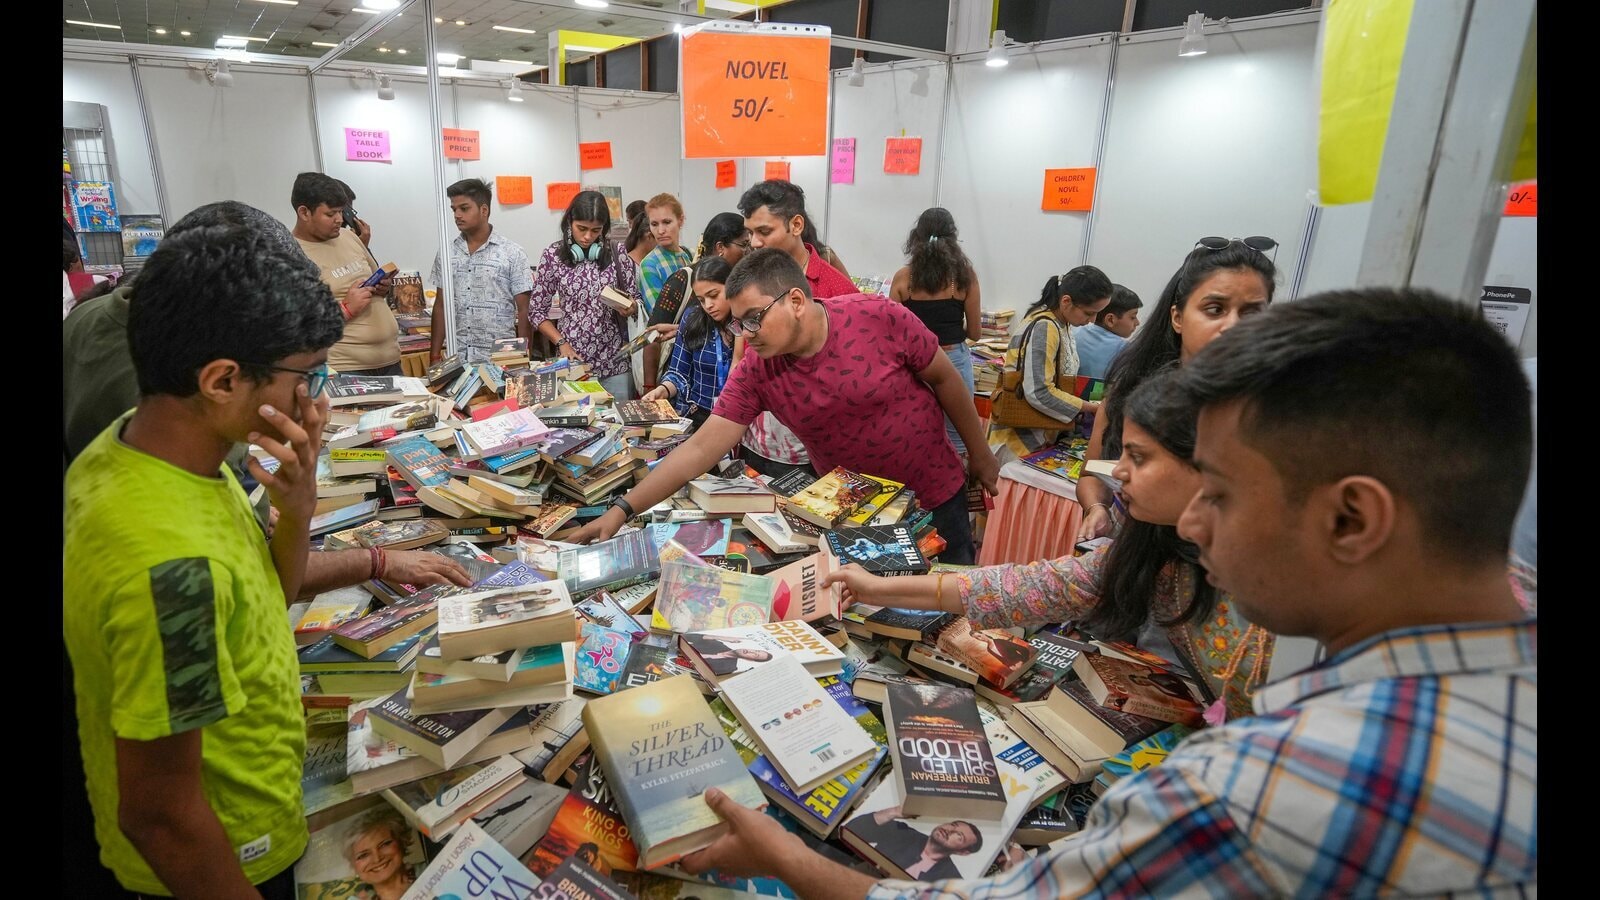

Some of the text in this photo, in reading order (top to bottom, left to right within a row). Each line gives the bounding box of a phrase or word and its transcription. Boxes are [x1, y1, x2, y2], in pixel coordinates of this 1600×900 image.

[726, 61, 788, 79] NOVEL
[732, 97, 773, 121] 50/-
[352, 130, 382, 138] COFFEE
[1510, 192, 1531, 204] 0/-
[391, 276, 421, 286] JANTA
[1487, 291, 1516, 299] PhonePe
[402, 448, 431, 463] bed
[407, 454, 449, 471] narrow
[893, 527, 912, 546] RIG
[901, 546, 920, 566] THE
[802, 564, 816, 616] KISMET
[762, 623, 804, 652] DYER
[780, 621, 835, 655] DANNY
[1038, 654, 1073, 669] PATH
[832, 684, 844, 692] for
[832, 691, 850, 700] hing
[382, 701, 417, 721] SHARON
[417, 717, 455, 738] BOLTON
[650, 720, 672, 732] THE
[629, 722, 714, 757] SILVER
[899, 738, 980, 761] BLOOD
[628, 737, 724, 777] THREAD
[920, 759, 996, 776] SPILLED
[460, 766, 502, 794] SHADOWS
[641, 758, 728, 790] KYLIE FITZPATRICK
[912, 772, 990, 784] BRIAN FREEMAN
[804, 779, 848, 819] DEE
[583, 806, 614, 830] KING
[584, 821, 624, 849] KINGS
[422, 832, 475, 891] Alison Penton
[460, 850, 504, 898] UP
